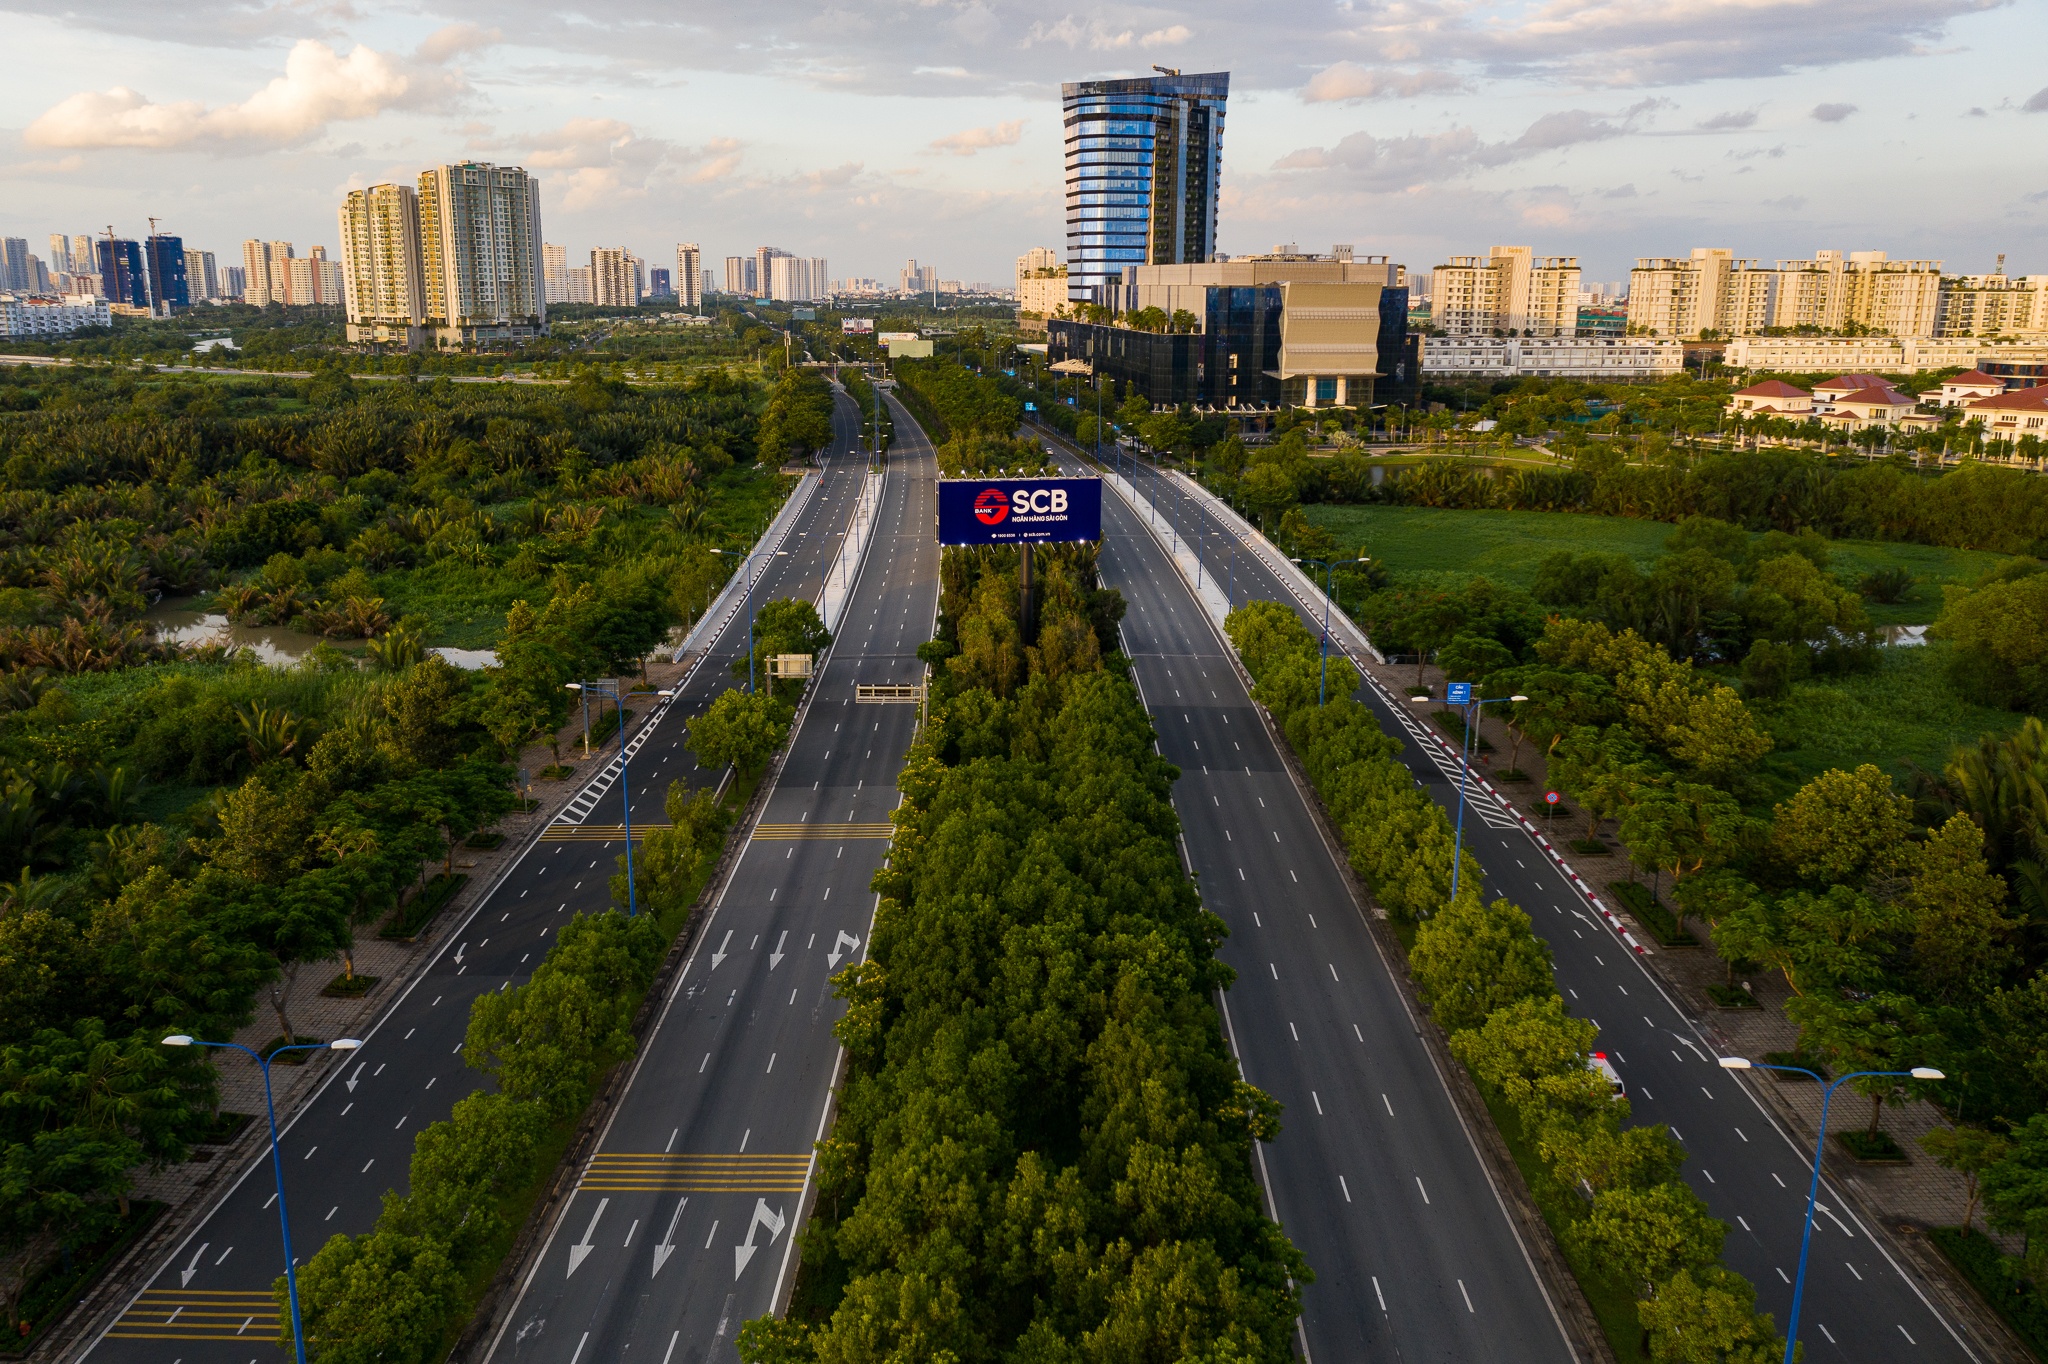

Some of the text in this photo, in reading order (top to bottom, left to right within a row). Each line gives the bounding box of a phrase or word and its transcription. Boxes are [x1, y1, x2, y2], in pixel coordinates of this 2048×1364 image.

[1012, 489, 1068, 514] SCB
[1029, 514, 1045, 522] HÀNG
[1045, 514, 1055, 522] SÀI
